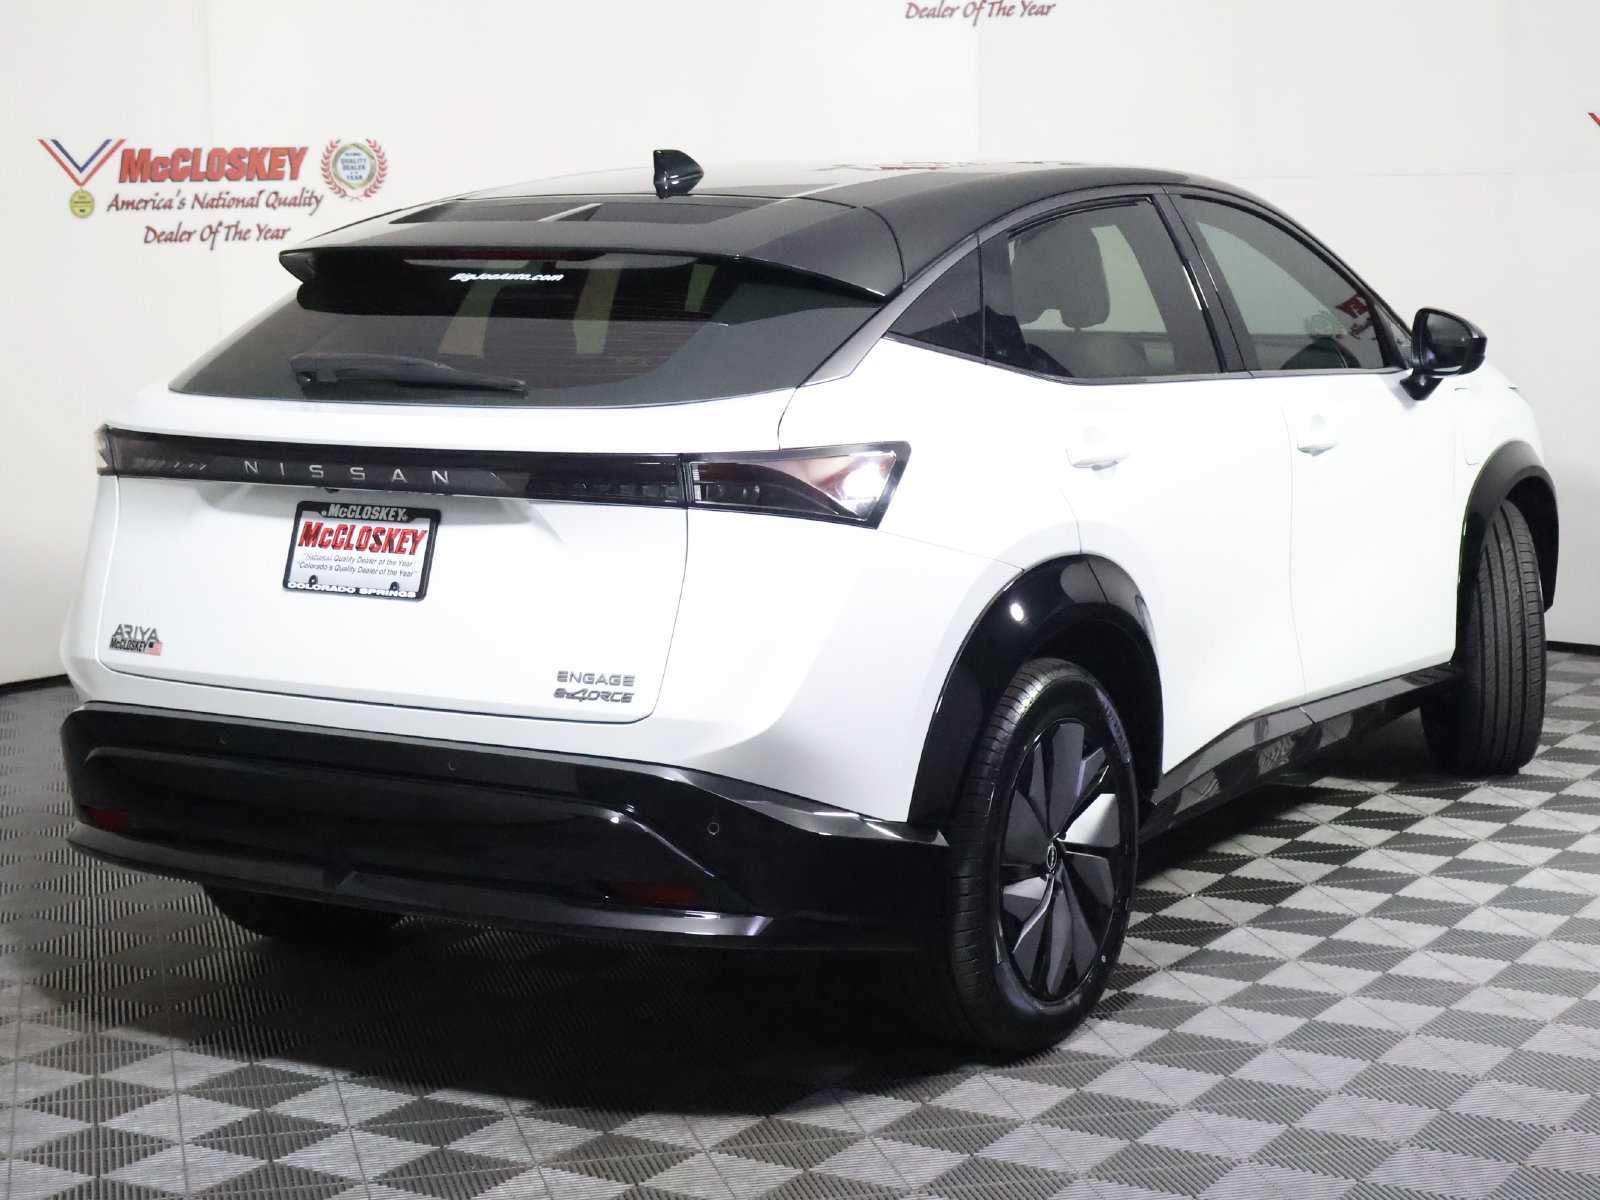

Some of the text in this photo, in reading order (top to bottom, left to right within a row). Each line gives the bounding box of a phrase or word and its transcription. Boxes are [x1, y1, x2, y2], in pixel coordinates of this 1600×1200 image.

[905, 0, 1056, 27] Dealer Of The Year
[119, 146, 308, 184] McCLOSKEY
[106, 189, 187, 213] America's
[190, 189, 264, 211] National
[266, 188, 324, 216] Quality
[144, 220, 292, 251] Dealer Of The Year
[244, 460, 450, 485] NISSAN
[327, 503, 406, 522] McCLOSKEY
[298, 521, 428, 555] McCLOSKEY
[333, 554, 356, 564] Quality
[356, 556, 377, 565] Dealer
[378, 558, 386, 566] of
[386, 559, 397, 567] the
[334, 564, 356, 574] Quality
[357, 566, 378, 574] Dealer
[386, 569, 398, 577] the
[287, 582, 417, 598] COLORADO SPRINGS
[111, 623, 160, 641] ARIYA
[557, 670, 635, 687] ENGAGE
